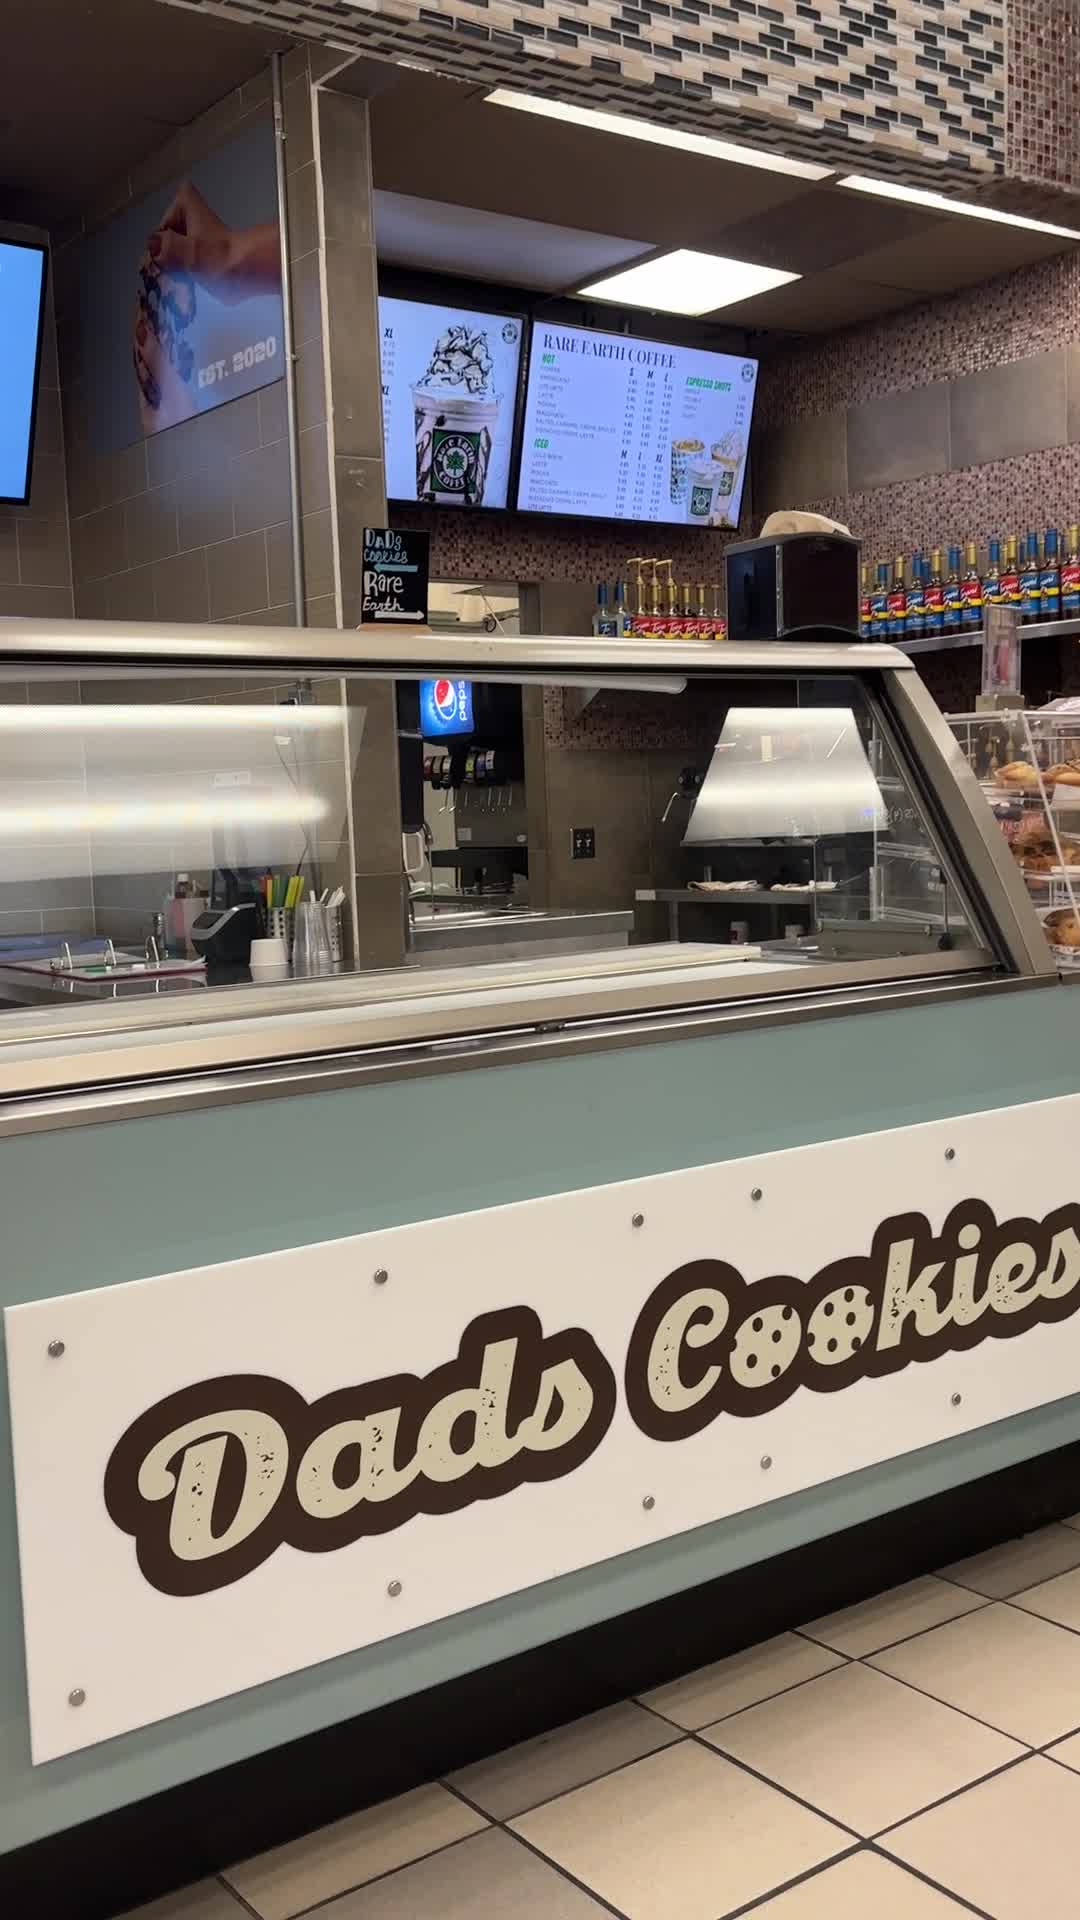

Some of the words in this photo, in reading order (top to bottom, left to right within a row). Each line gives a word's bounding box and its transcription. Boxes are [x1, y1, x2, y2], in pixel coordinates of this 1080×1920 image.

[232, 336, 276, 373] 2020
[542, 353, 555, 364] HOT
[544, 334, 577, 353] RARE
[582, 340, 625, 361] EARTH
[628, 348, 676, 369] COFFEE
[534, 439, 549, 449] ICED
[363, 571, 404, 597] Rare
[362, 596, 405, 612] Earth
[138, 1337, 593, 1560] Dads
[647, 1223, 1080, 1412] Cookies
